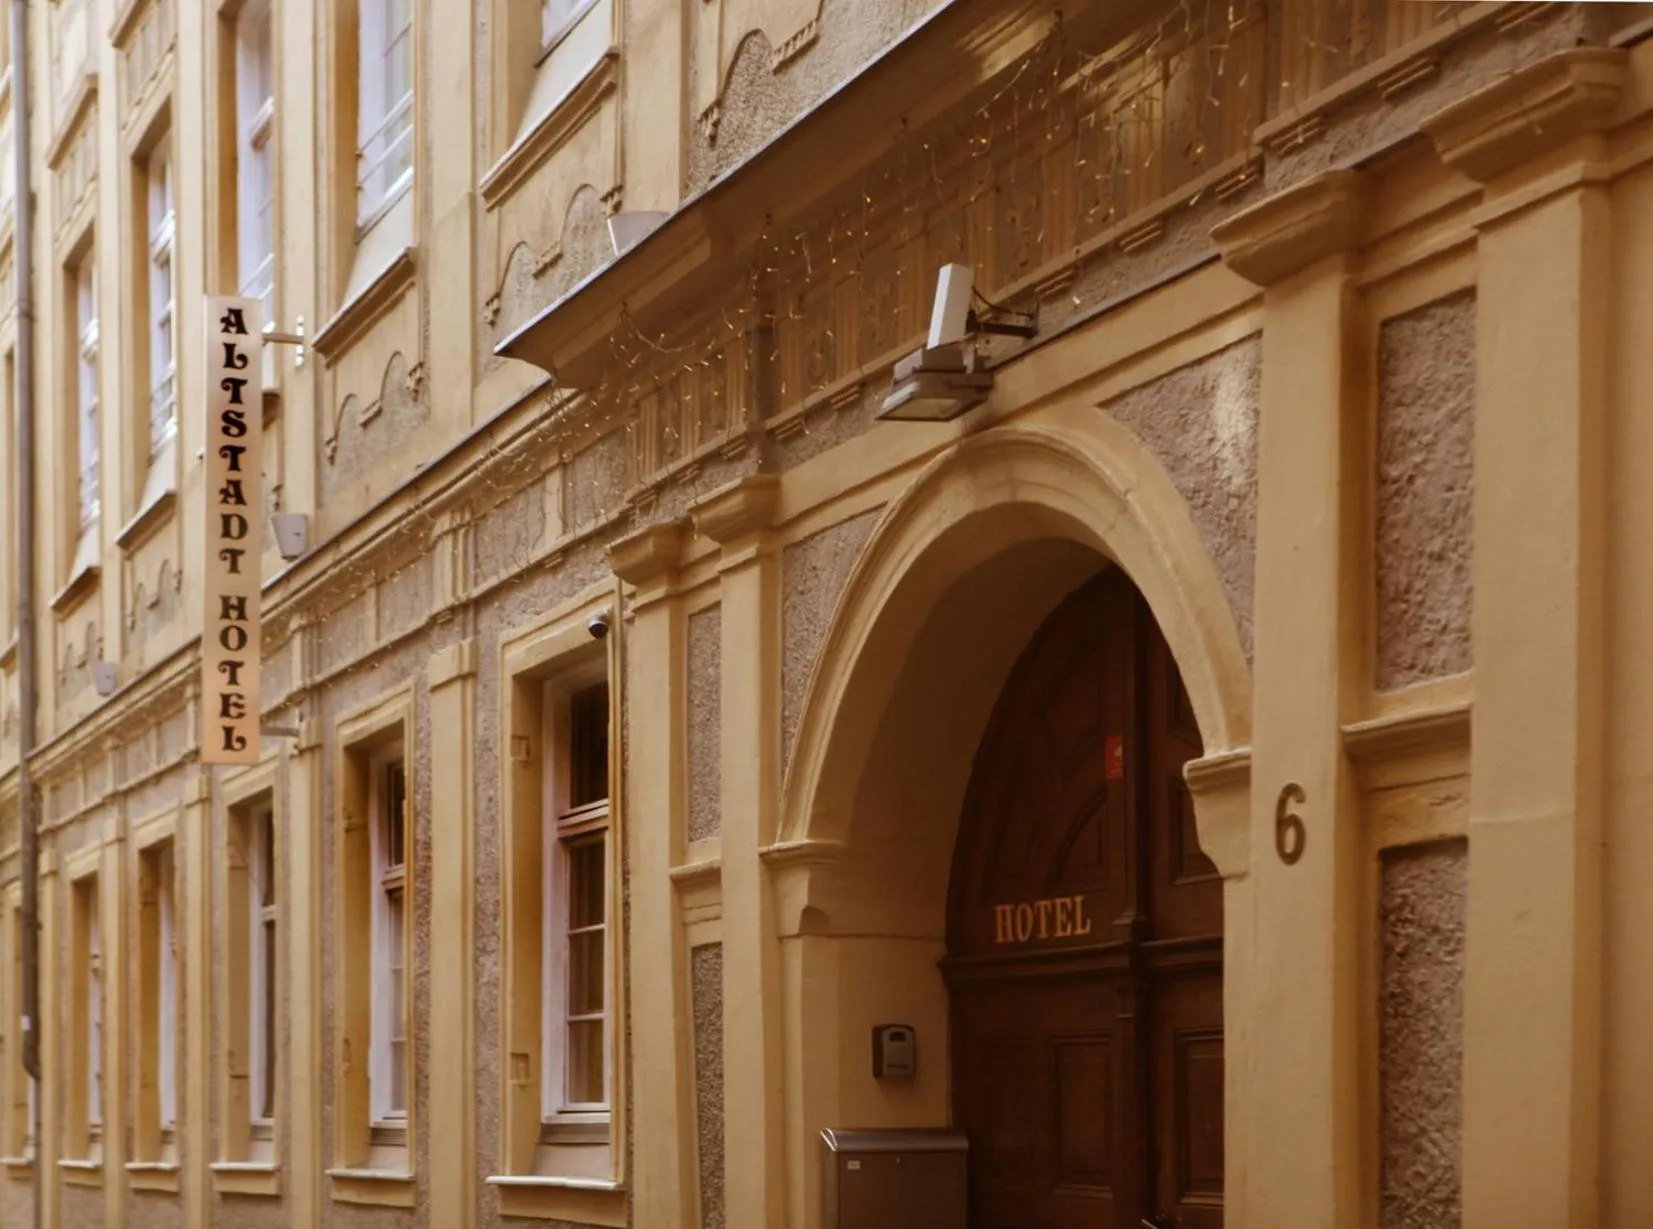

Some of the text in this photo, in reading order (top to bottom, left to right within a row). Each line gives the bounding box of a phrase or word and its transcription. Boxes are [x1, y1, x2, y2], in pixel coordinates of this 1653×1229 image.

[217, 308, 249, 752] ALTSTADT HOTEL
[1275, 782, 1306, 866] 6
[993, 895, 1091, 943] HOTEL
